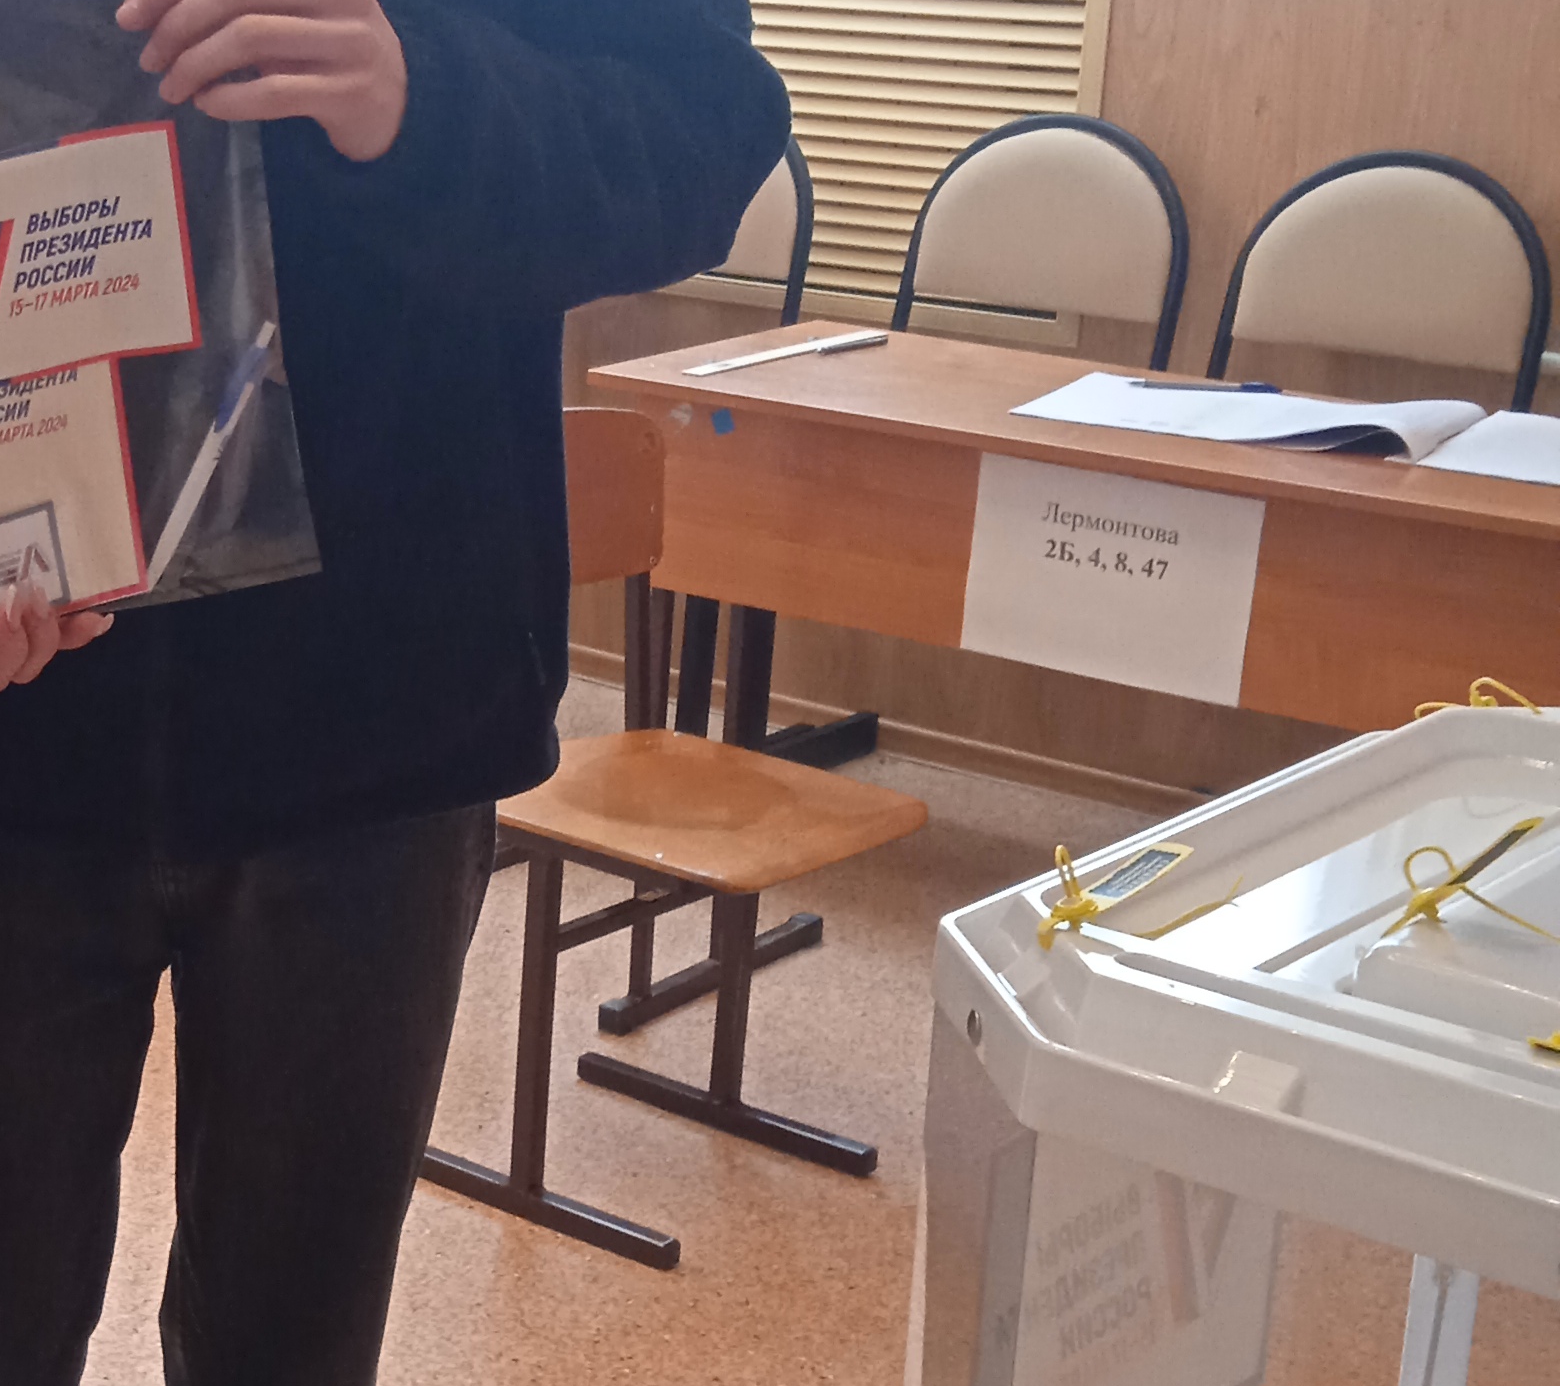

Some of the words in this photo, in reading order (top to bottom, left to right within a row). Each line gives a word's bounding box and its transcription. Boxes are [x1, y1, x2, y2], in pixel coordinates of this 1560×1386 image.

[26, 196, 121, 235] ВЫБОРЫ
[19, 218, 153, 264] ПРЕЗИДЕНТА
[13, 255, 96, 293] РОССИИ
[49, 280, 100, 310] МАРТА
[102, 273, 140, 296] 2024
[37, 413, 68, 435] 2024
[1041, 501, 1179, 546] Лермонтова
[1044, 538, 1081, 568] 2Б,
[1087, 547, 1107, 572] 4,
[1114, 551, 1134, 576] 8,
[1141, 558, 1169, 580] 47
